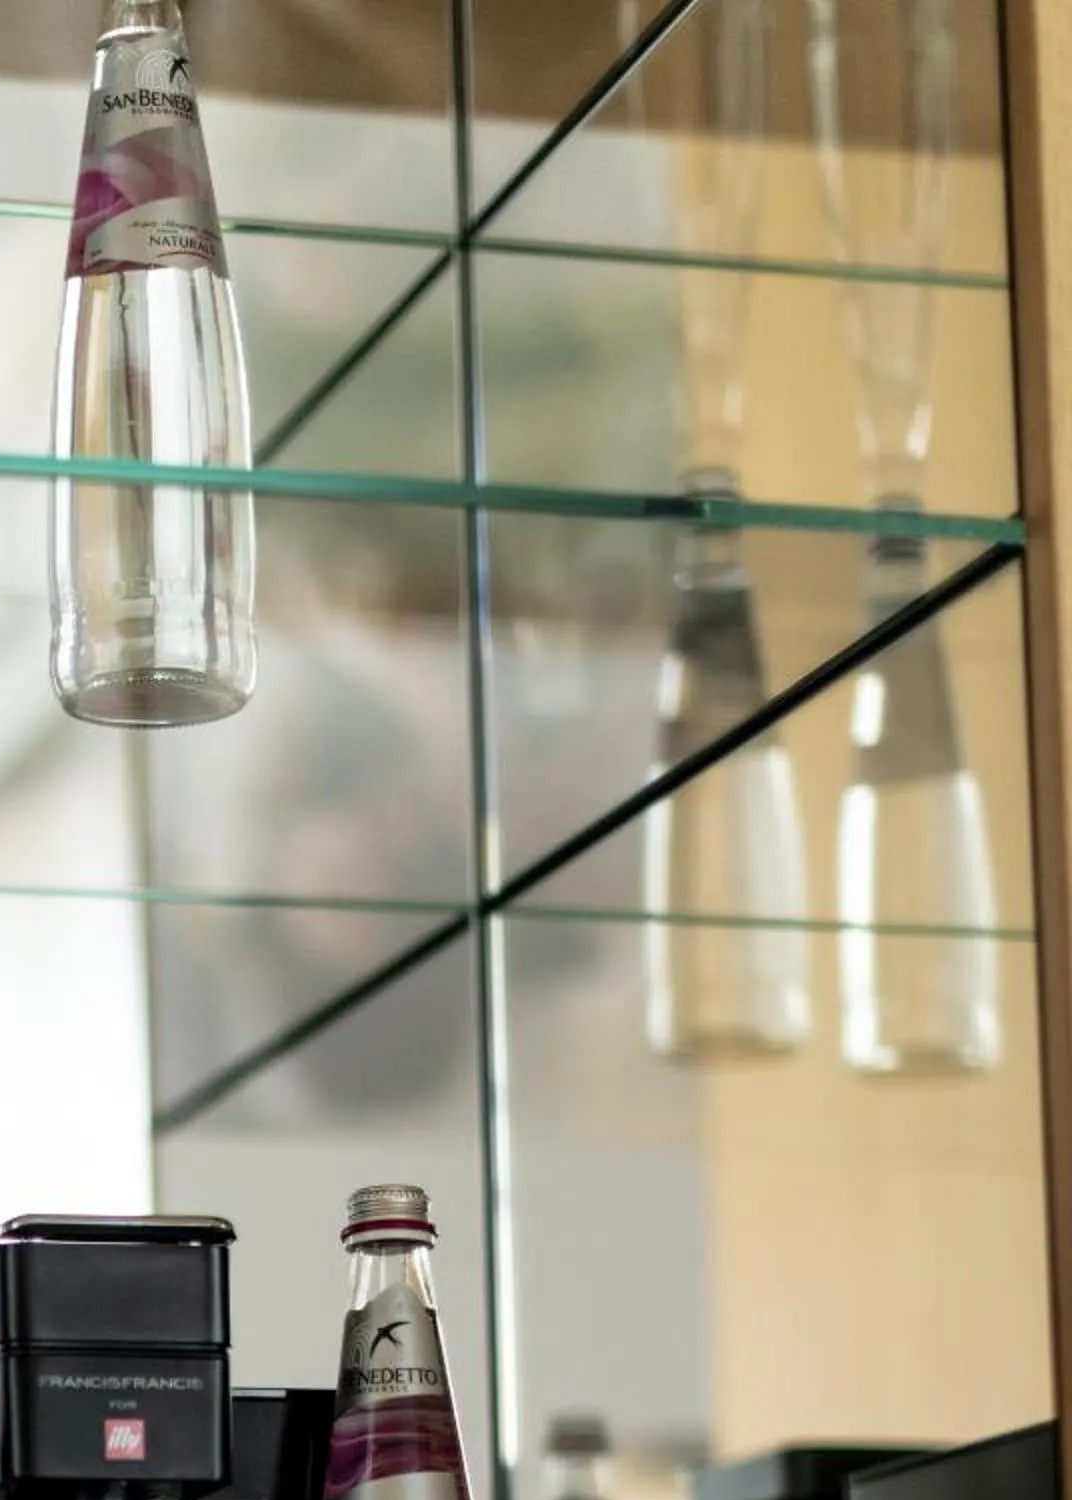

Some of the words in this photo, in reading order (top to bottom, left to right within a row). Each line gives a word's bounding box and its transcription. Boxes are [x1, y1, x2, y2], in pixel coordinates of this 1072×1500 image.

[102, 92, 137, 114] SAN
[39, 1374, 204, 1391] FRANCISFRANCIS
[108, 1424, 143, 1449] illy
